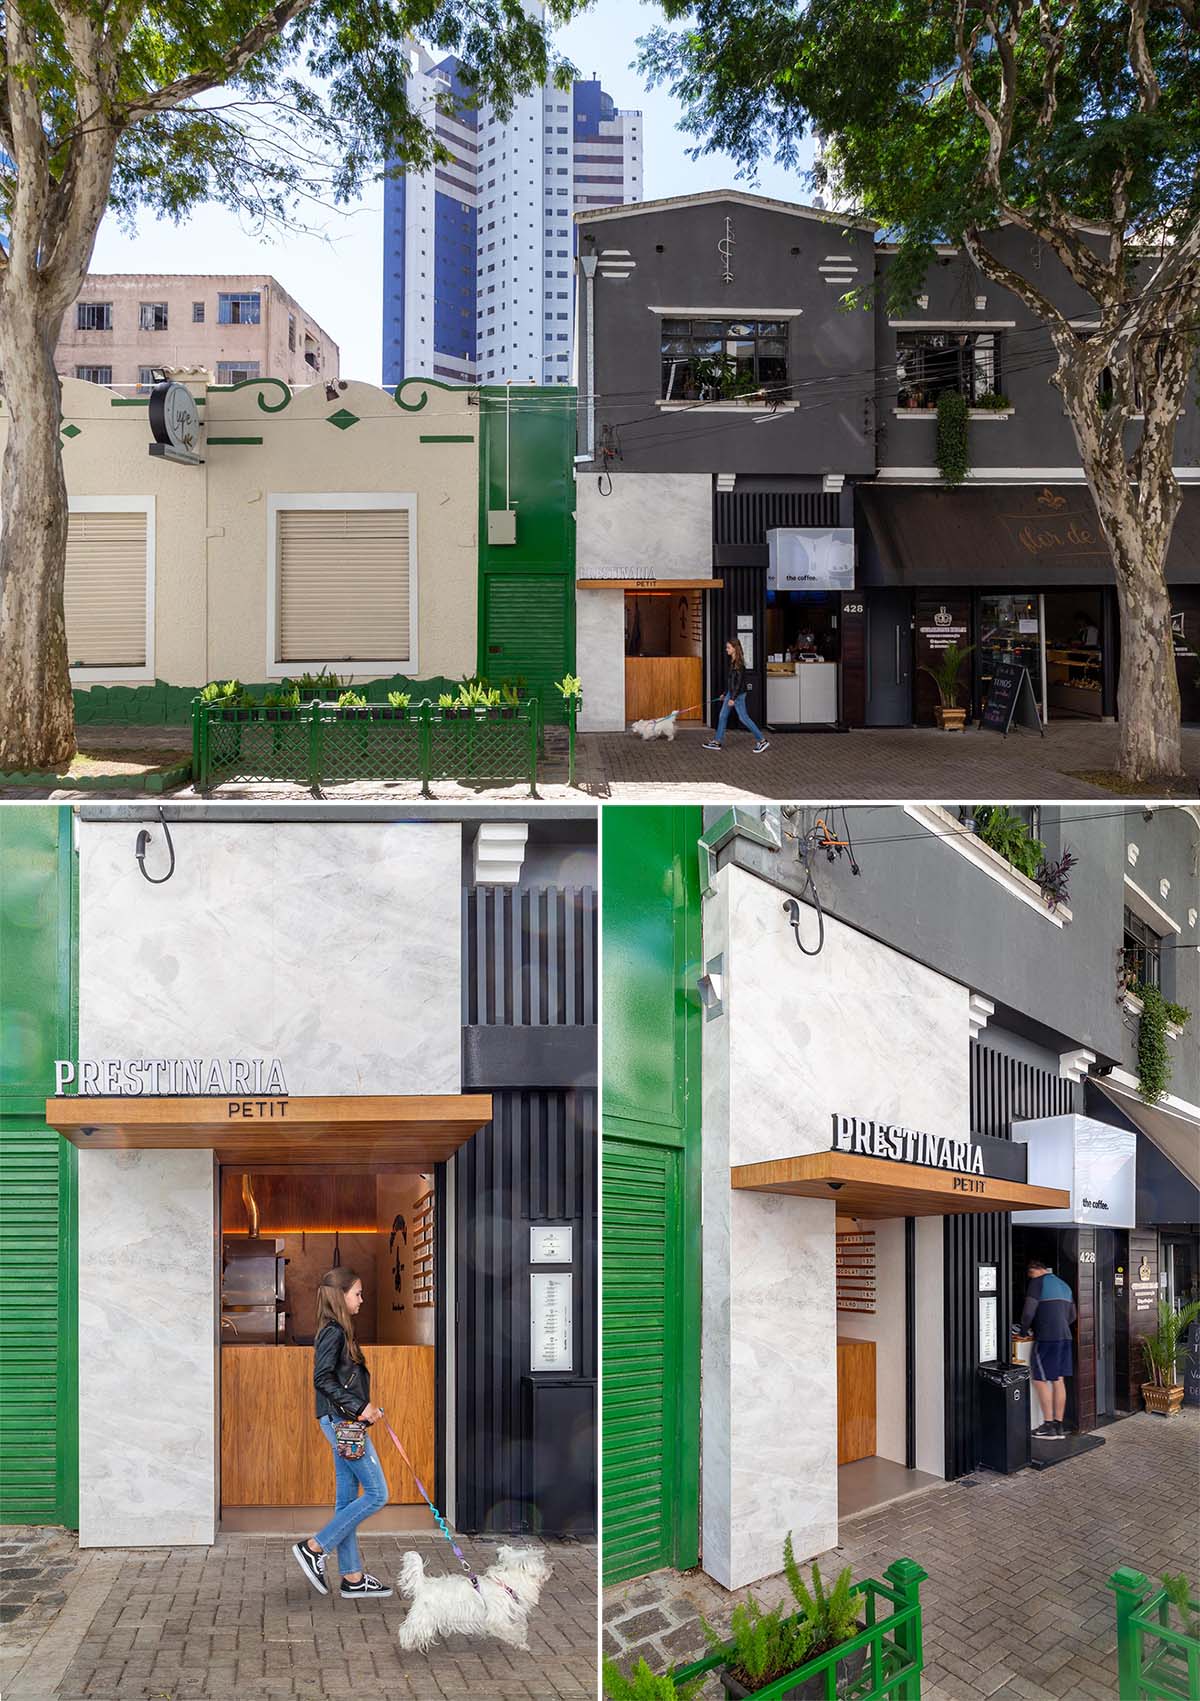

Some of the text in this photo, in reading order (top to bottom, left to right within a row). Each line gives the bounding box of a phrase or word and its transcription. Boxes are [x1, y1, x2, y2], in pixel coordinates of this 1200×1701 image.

[843, 605, 864, 613] 428
[53, 1059, 289, 1097] PRESTINARIA
[228, 1101, 289, 1118] PETIT
[832, 1112, 986, 1176] PRESTINARIA
[952, 1176, 987, 1194] PETIT
[1082, 1198, 1092, 1208] the
[1079, 1252, 1096, 1263] 428
